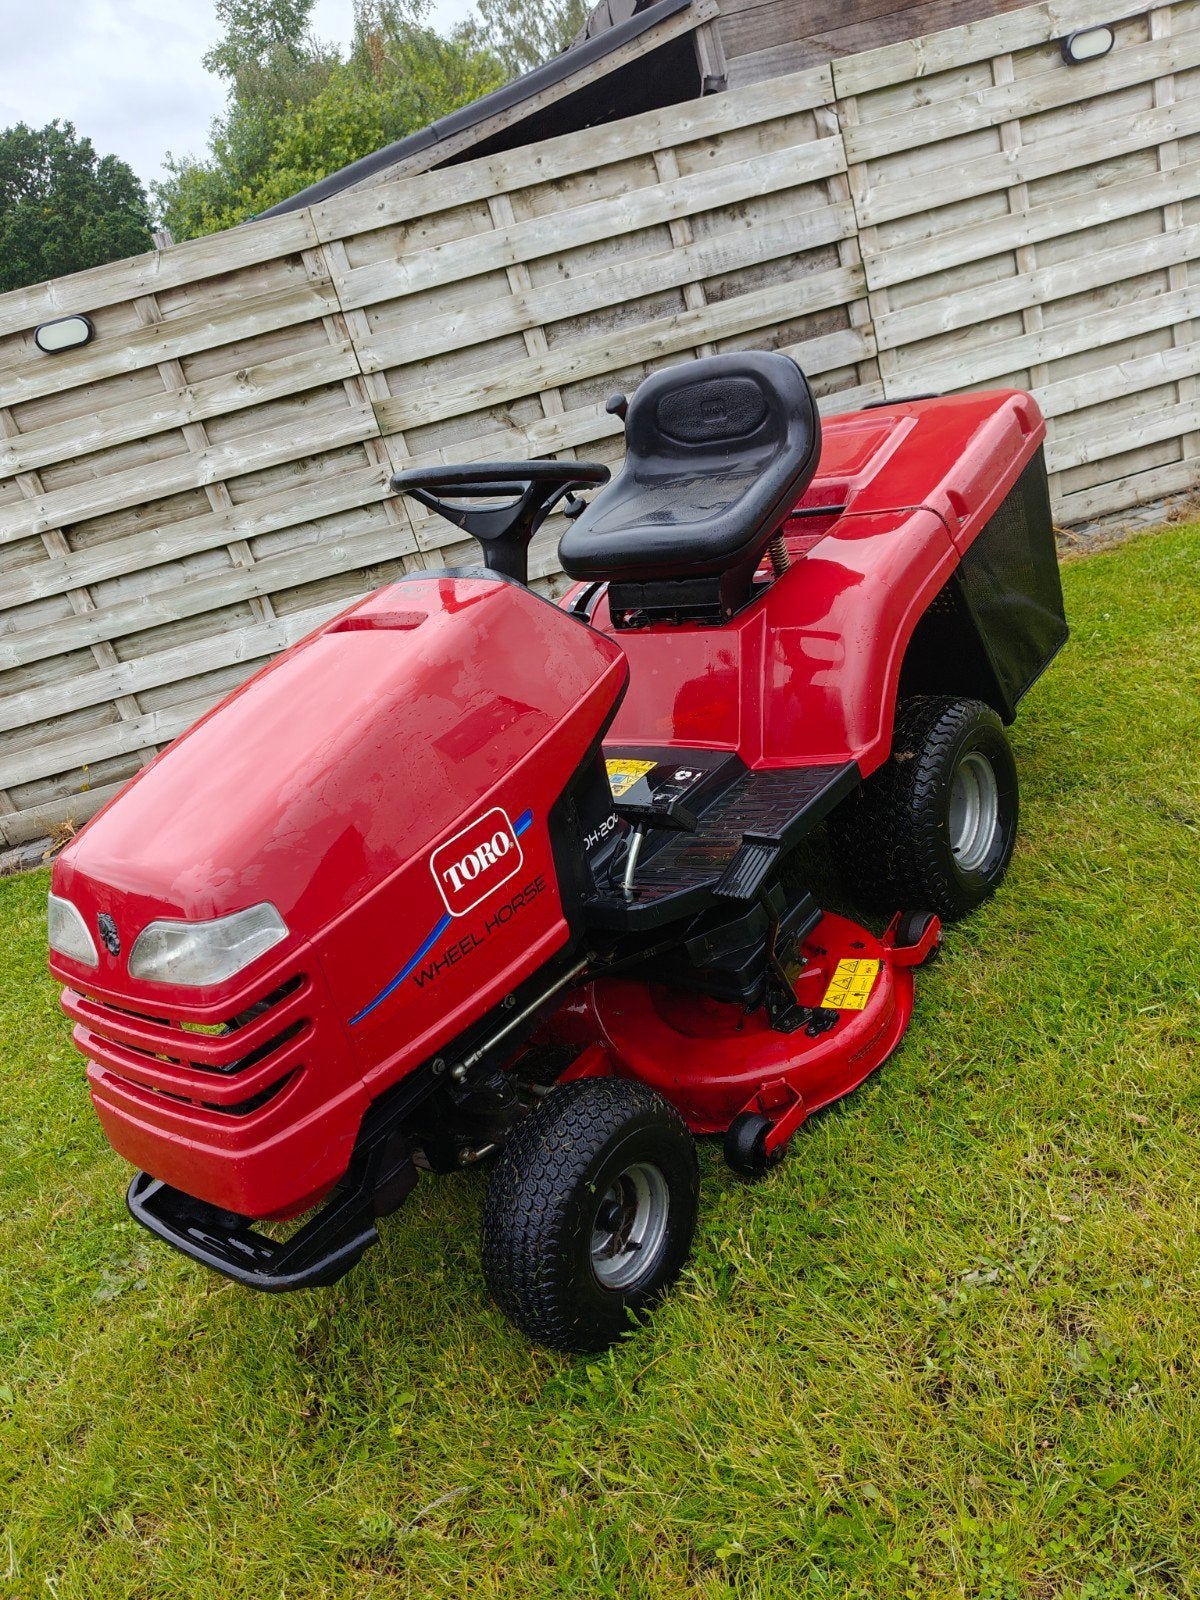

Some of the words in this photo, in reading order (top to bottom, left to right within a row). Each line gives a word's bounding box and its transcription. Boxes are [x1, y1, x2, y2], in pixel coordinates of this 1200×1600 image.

[443, 831, 510, 892] TORO
[413, 934, 484, 987] WHEEL
[485, 875, 547, 935] HORSE
